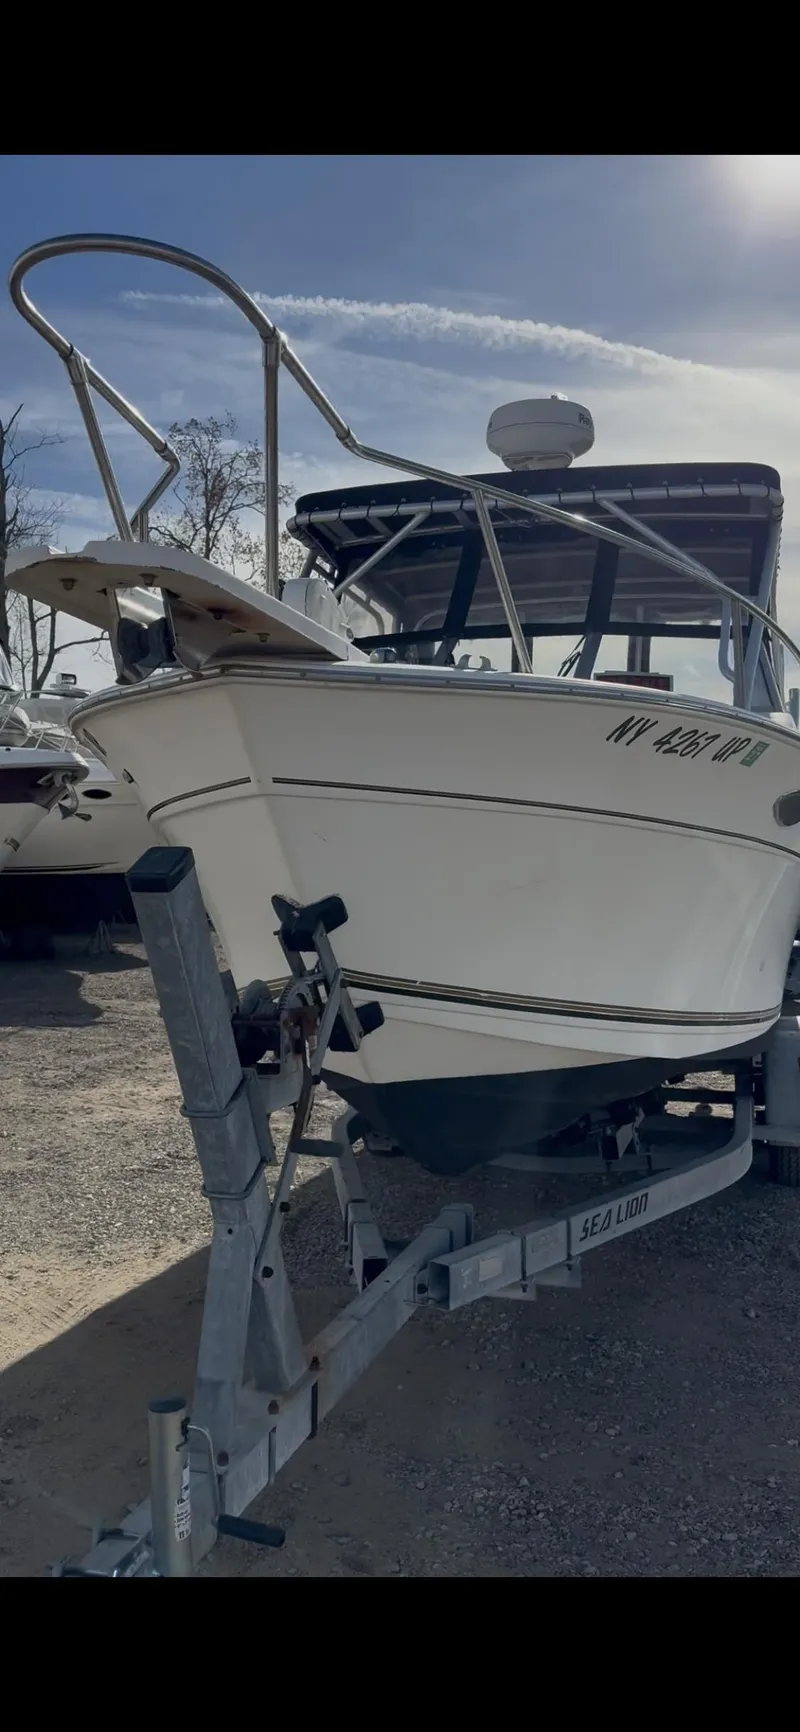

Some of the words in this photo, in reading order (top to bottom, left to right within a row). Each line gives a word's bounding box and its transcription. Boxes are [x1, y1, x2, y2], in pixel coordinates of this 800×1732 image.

[606, 715, 658, 746] NY
[653, 726, 721, 759] 4267
[711, 737, 752, 763] UP
[579, 1208, 612, 1242] SEA
[616, 1192, 649, 1225] LION
